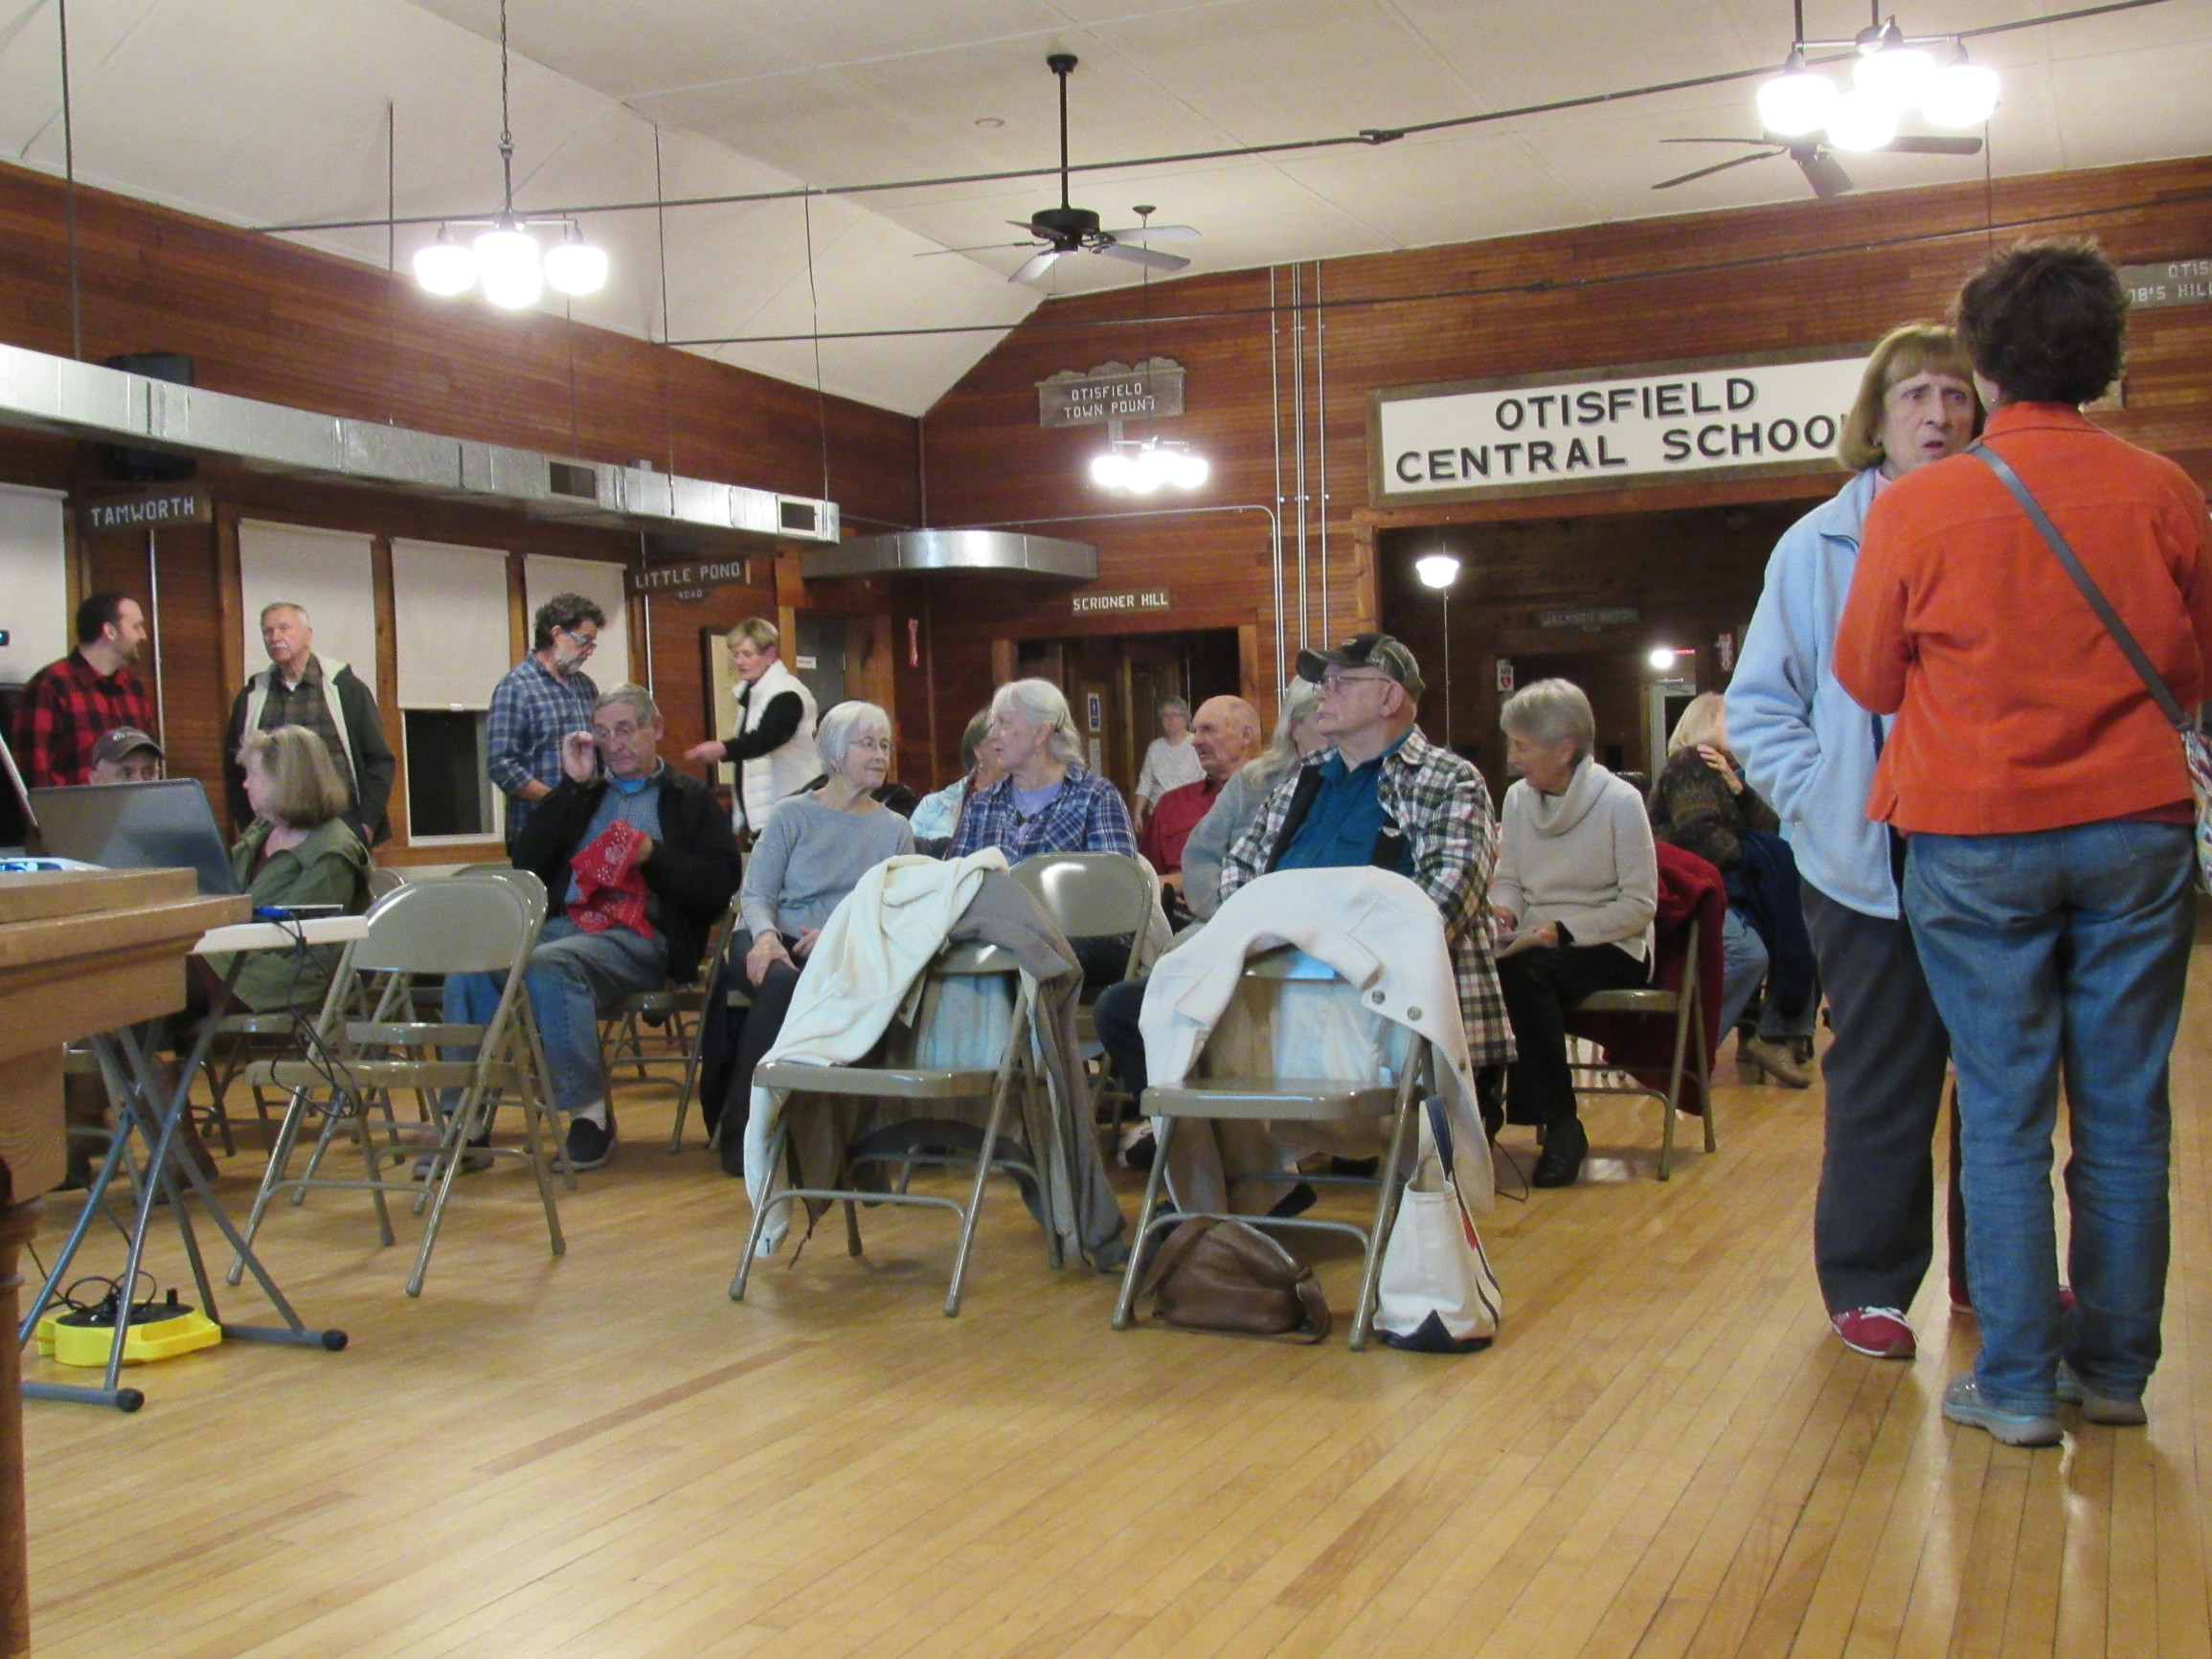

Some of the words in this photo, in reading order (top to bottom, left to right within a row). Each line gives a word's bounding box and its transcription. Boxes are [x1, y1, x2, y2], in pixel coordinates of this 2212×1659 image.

[2168, 259, 2212, 279] OTIS
[1072, 382, 1142, 402] OTISFIELD
[1064, 403, 1103, 419] TOWN
[1495, 377, 1758, 432] OTISFIELD
[1395, 435, 1628, 483] CENTRAL
[1661, 414, 1845, 463] SCHOO
[90, 495, 195, 527] TAMWORTH
[635, 567, 692, 589] LITTLE
[700, 561, 740, 581] POND
[1140, 592, 1168, 607] HILL
